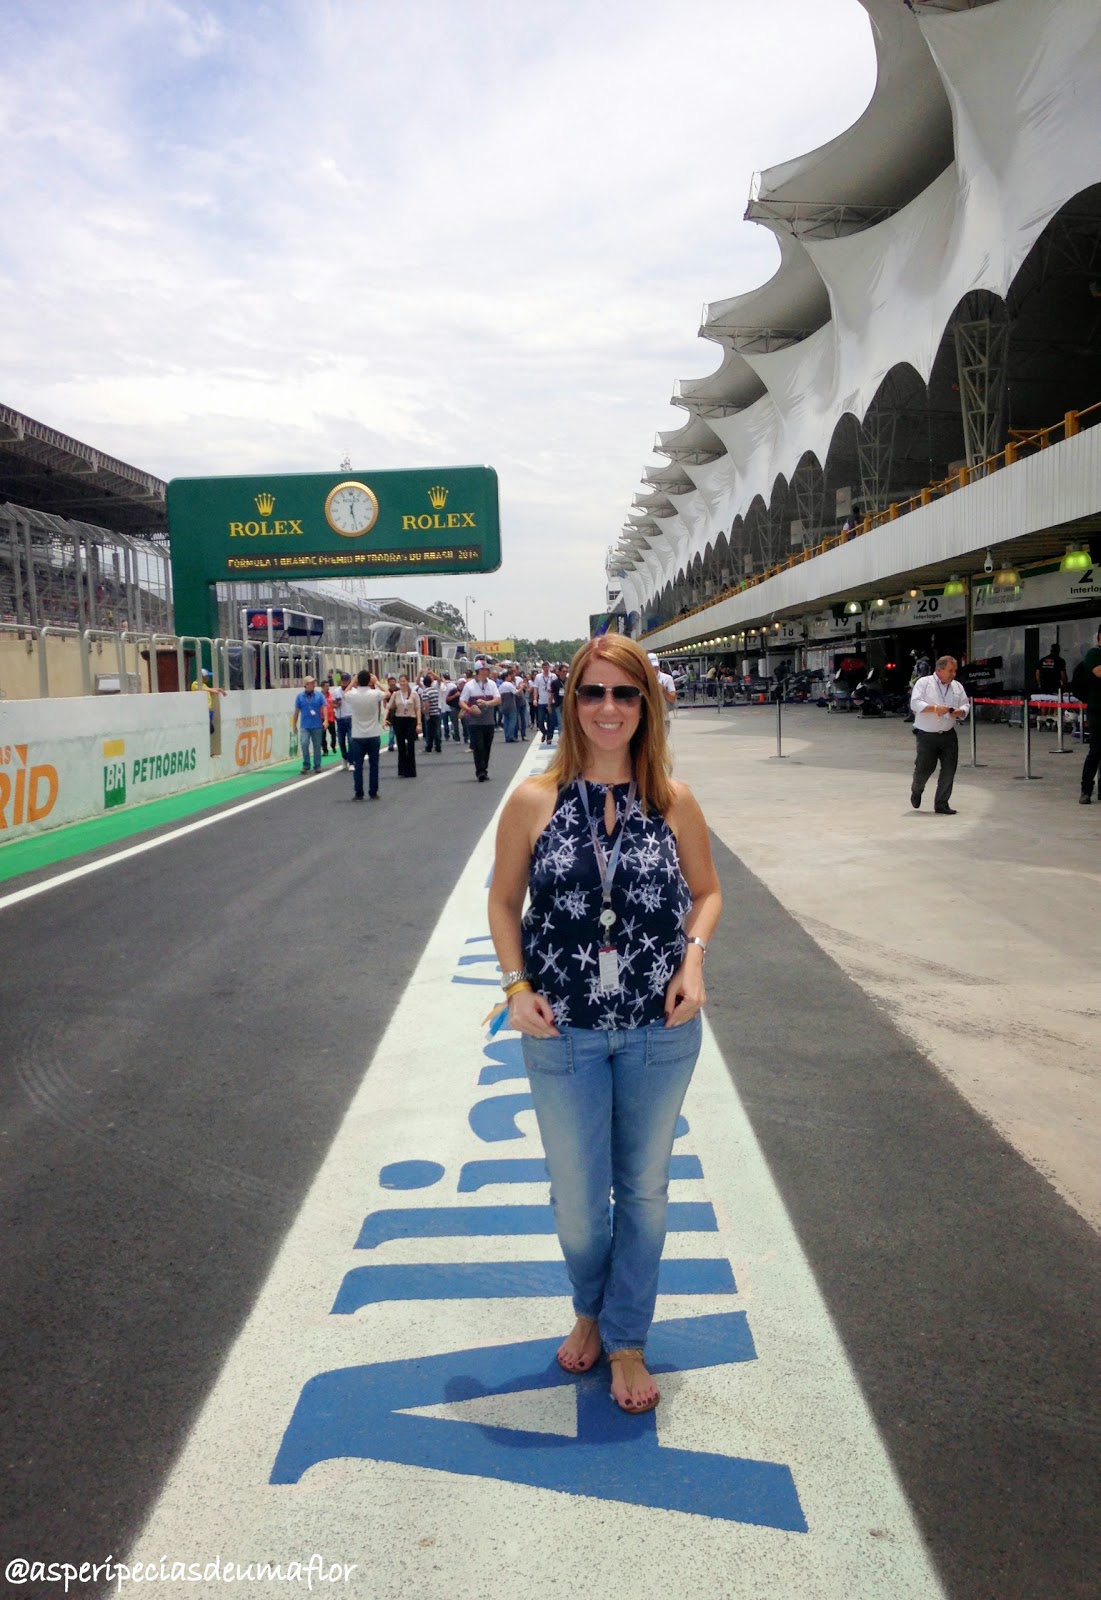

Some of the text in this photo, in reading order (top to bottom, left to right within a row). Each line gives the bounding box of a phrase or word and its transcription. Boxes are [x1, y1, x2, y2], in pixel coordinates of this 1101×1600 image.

[229, 519, 304, 537] ROLEX
[401, 512, 477, 530] ROLEX
[1070, 585, 1101, 594] Interla
[917, 597, 939, 612] 20
[834, 617, 849, 627] 19
[782, 628, 794, 637] 18
[235, 727, 273, 767] GRID
[105, 747, 196, 791] BR PETROBRAS
